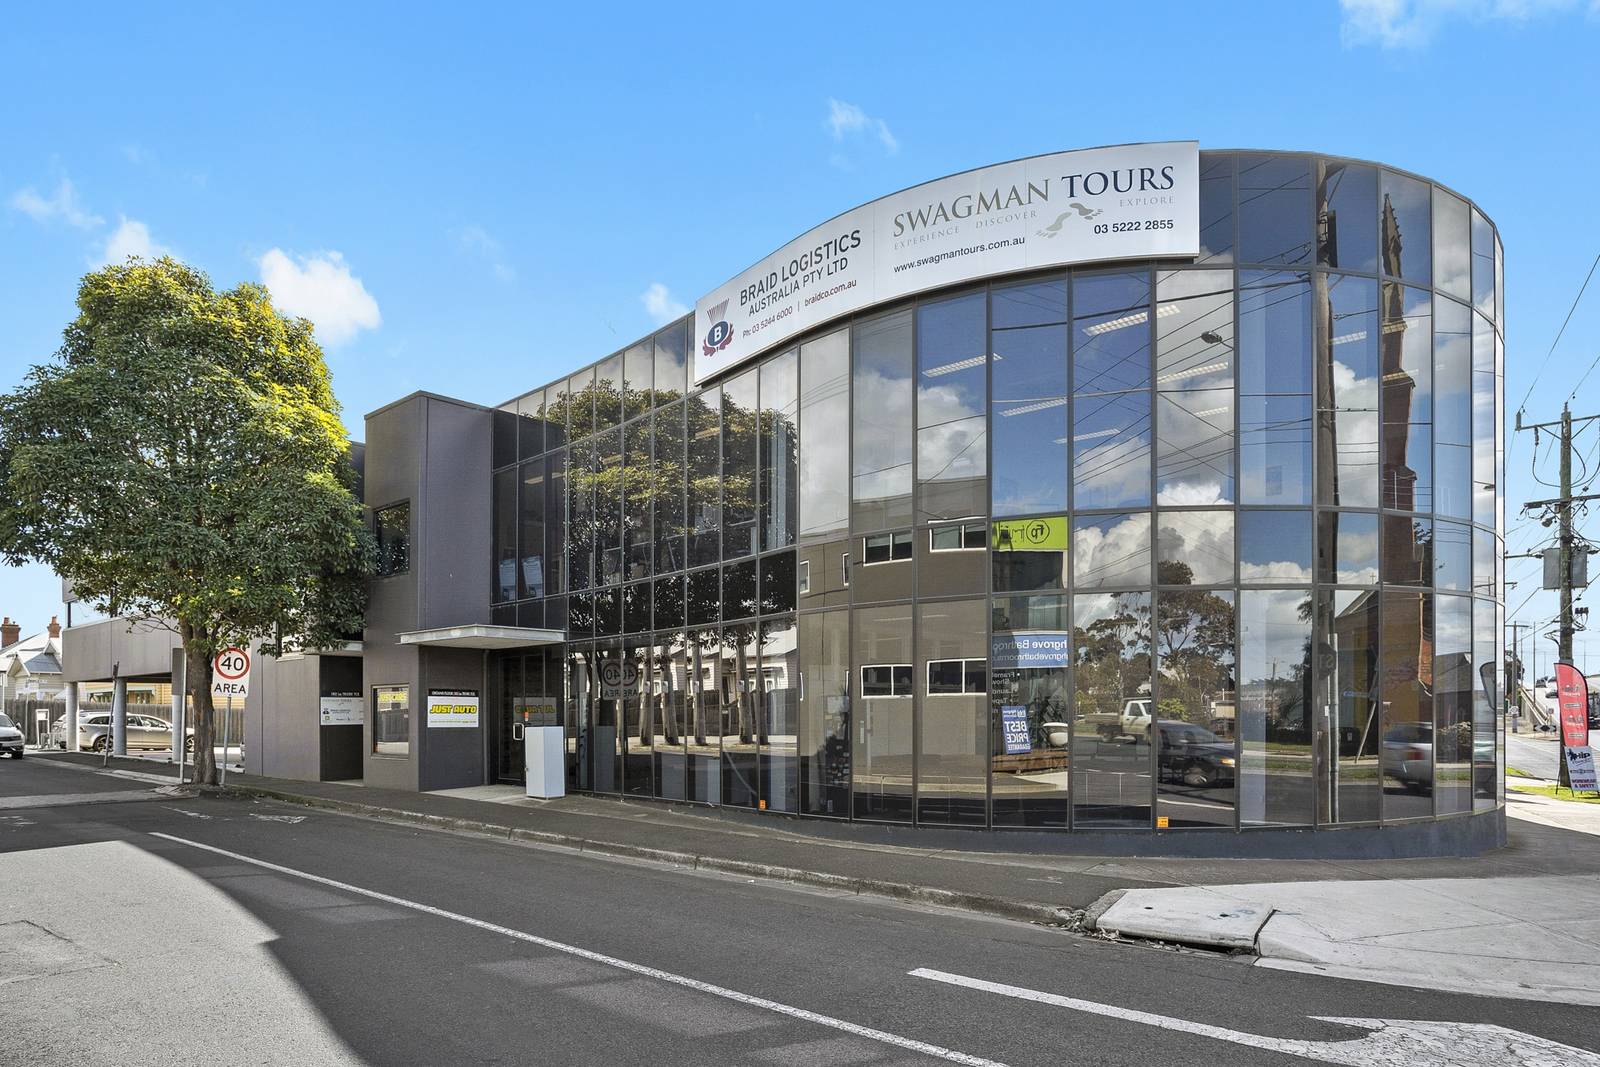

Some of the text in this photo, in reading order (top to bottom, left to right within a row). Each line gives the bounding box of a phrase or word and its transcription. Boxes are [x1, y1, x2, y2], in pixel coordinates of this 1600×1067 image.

[893, 165, 1174, 238] SWAGMAN TOURS
[894, 196, 1174, 250] EXPERIENCE DISCOVER EXPLORE
[1094, 219, 1174, 235] 03 5222 2855
[740, 229, 861, 306] BRAID LOGISTICS
[893, 236, 1026, 273] www.swagmantours.com.au
[749, 257, 848, 317] AUSTRALIA PTY LTD
[752, 324, 760, 333] 03
[760, 315, 776, 329] 5244
[776, 306, 793, 320] 6000
[804, 280, 857, 307] braidco.com.au
[714, 327, 722, 342] B
[221, 657, 244, 671] 40
[214, 683, 246, 694] AREA
[430, 704, 478, 714] JUST AUTO
